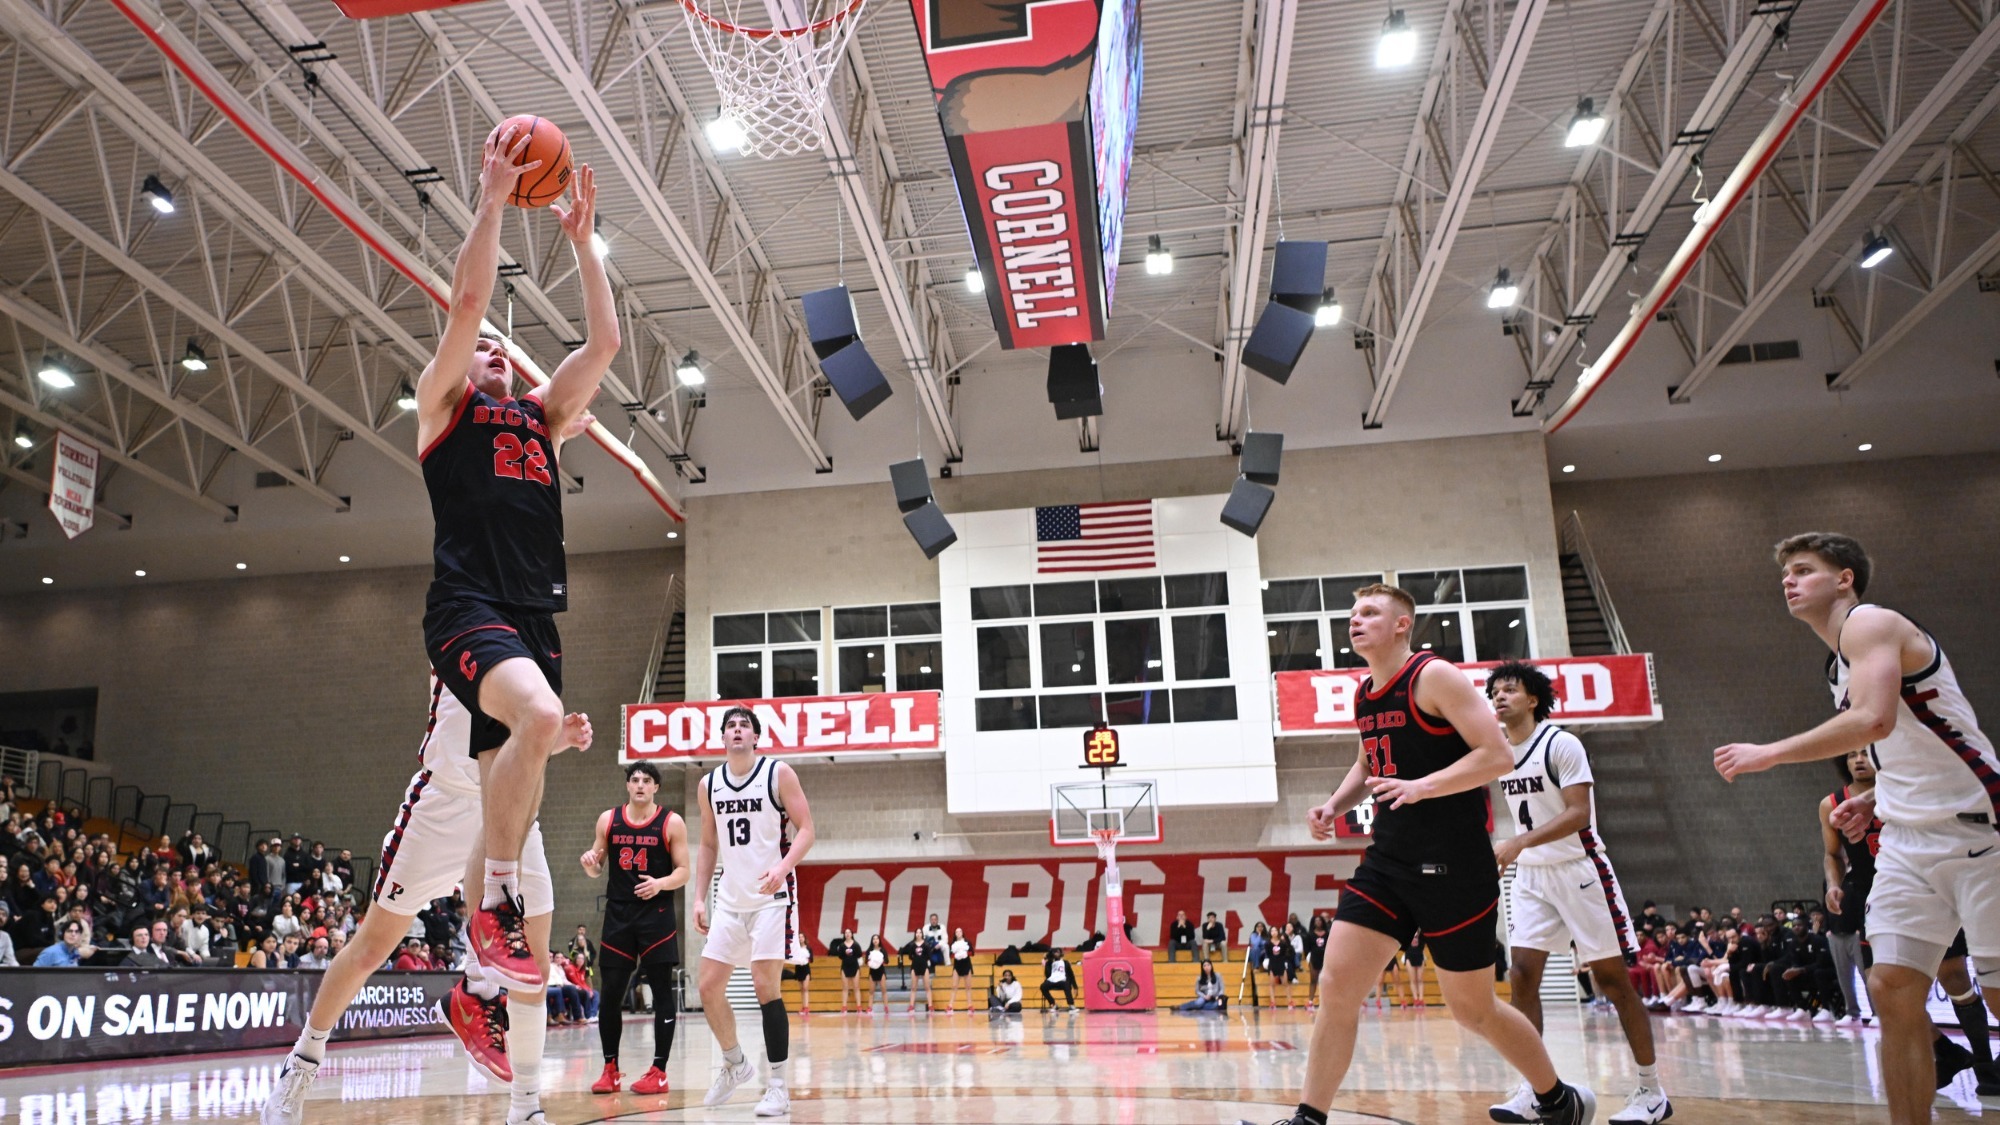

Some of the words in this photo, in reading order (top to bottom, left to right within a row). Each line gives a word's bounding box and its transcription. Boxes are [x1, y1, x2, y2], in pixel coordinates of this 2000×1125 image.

[984, 159, 1080, 329] CORNELL
[473, 406, 522, 426] BIG
[60, 443, 94, 470] CORNELL
[493, 432, 551, 486] 22
[1376, 710, 1406, 729] RED
[1089, 740, 1115, 762] 22
[1363, 734, 1397, 777] 31
[1500, 775, 1544, 796] PENN
[715, 798, 763, 815] PENN
[1518, 799, 1533, 832] 4
[612, 834, 634, 845] BIG
[635, 835, 659, 847] RED
[727, 818, 751, 847] 13
[619, 847, 648, 871] 24
[818, 866, 952, 953] GO
[976, 863, 1166, 953] BIG
[1197, 854, 1361, 952] RE
[27, 995, 96, 1041] ON
[101, 993, 199, 1037] SALE
[201, 991, 287, 1032] NOW!
